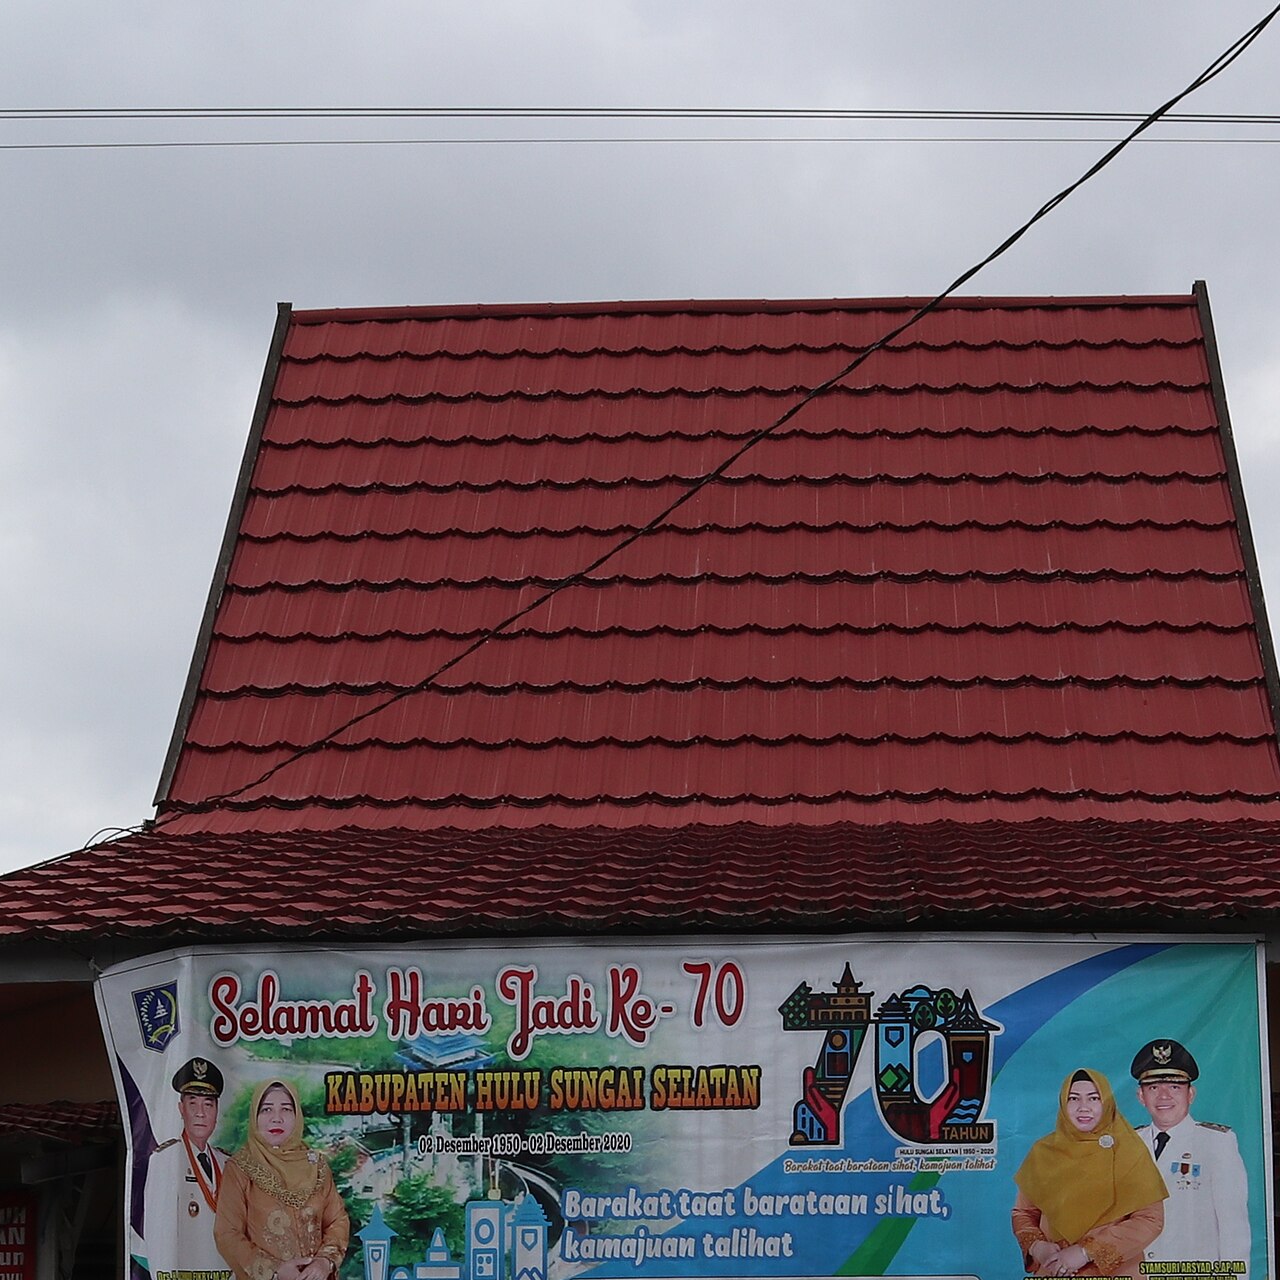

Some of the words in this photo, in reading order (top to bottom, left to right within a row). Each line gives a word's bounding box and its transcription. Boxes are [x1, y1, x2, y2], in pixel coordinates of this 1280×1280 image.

[213, 970, 373, 1042] Selamat
[389, 968, 487, 1036] Hari
[499, 966, 598, 1054] Jadi
[683, 962, 746, 1029] 70
[326, 1072, 467, 1113] KABUPATEN
[475, 1071, 540, 1110] HULU
[550, 1069, 643, 1109] SUNGAI
[653, 1068, 760, 1108] SELATAN
[420, 1136, 434, 1154] 02
[437, 1135, 490, 1153] Desember
[494, 1135, 520, 1152] 1950
[529, 1135, 544, 1152] 02
[547, 1133, 601, 1152] Desember
[604, 1134, 631, 1151] 2020
[942, 1126, 989, 1141] TAHUN
[784, 1160, 821, 1172] Barakat
[824, 1161, 844, 1171] taat
[847, 1159, 889, 1171] barataan
[920, 1160, 962, 1174] kamajuan
[565, 1191, 672, 1219] Barakat
[678, 1191, 736, 1215] taat
[743, 1187, 867, 1215] barataan
[874, 1186, 948, 1217] sihat,
[565, 1231, 694, 1264] kamajuan
[702, 1229, 792, 1258] talihat
